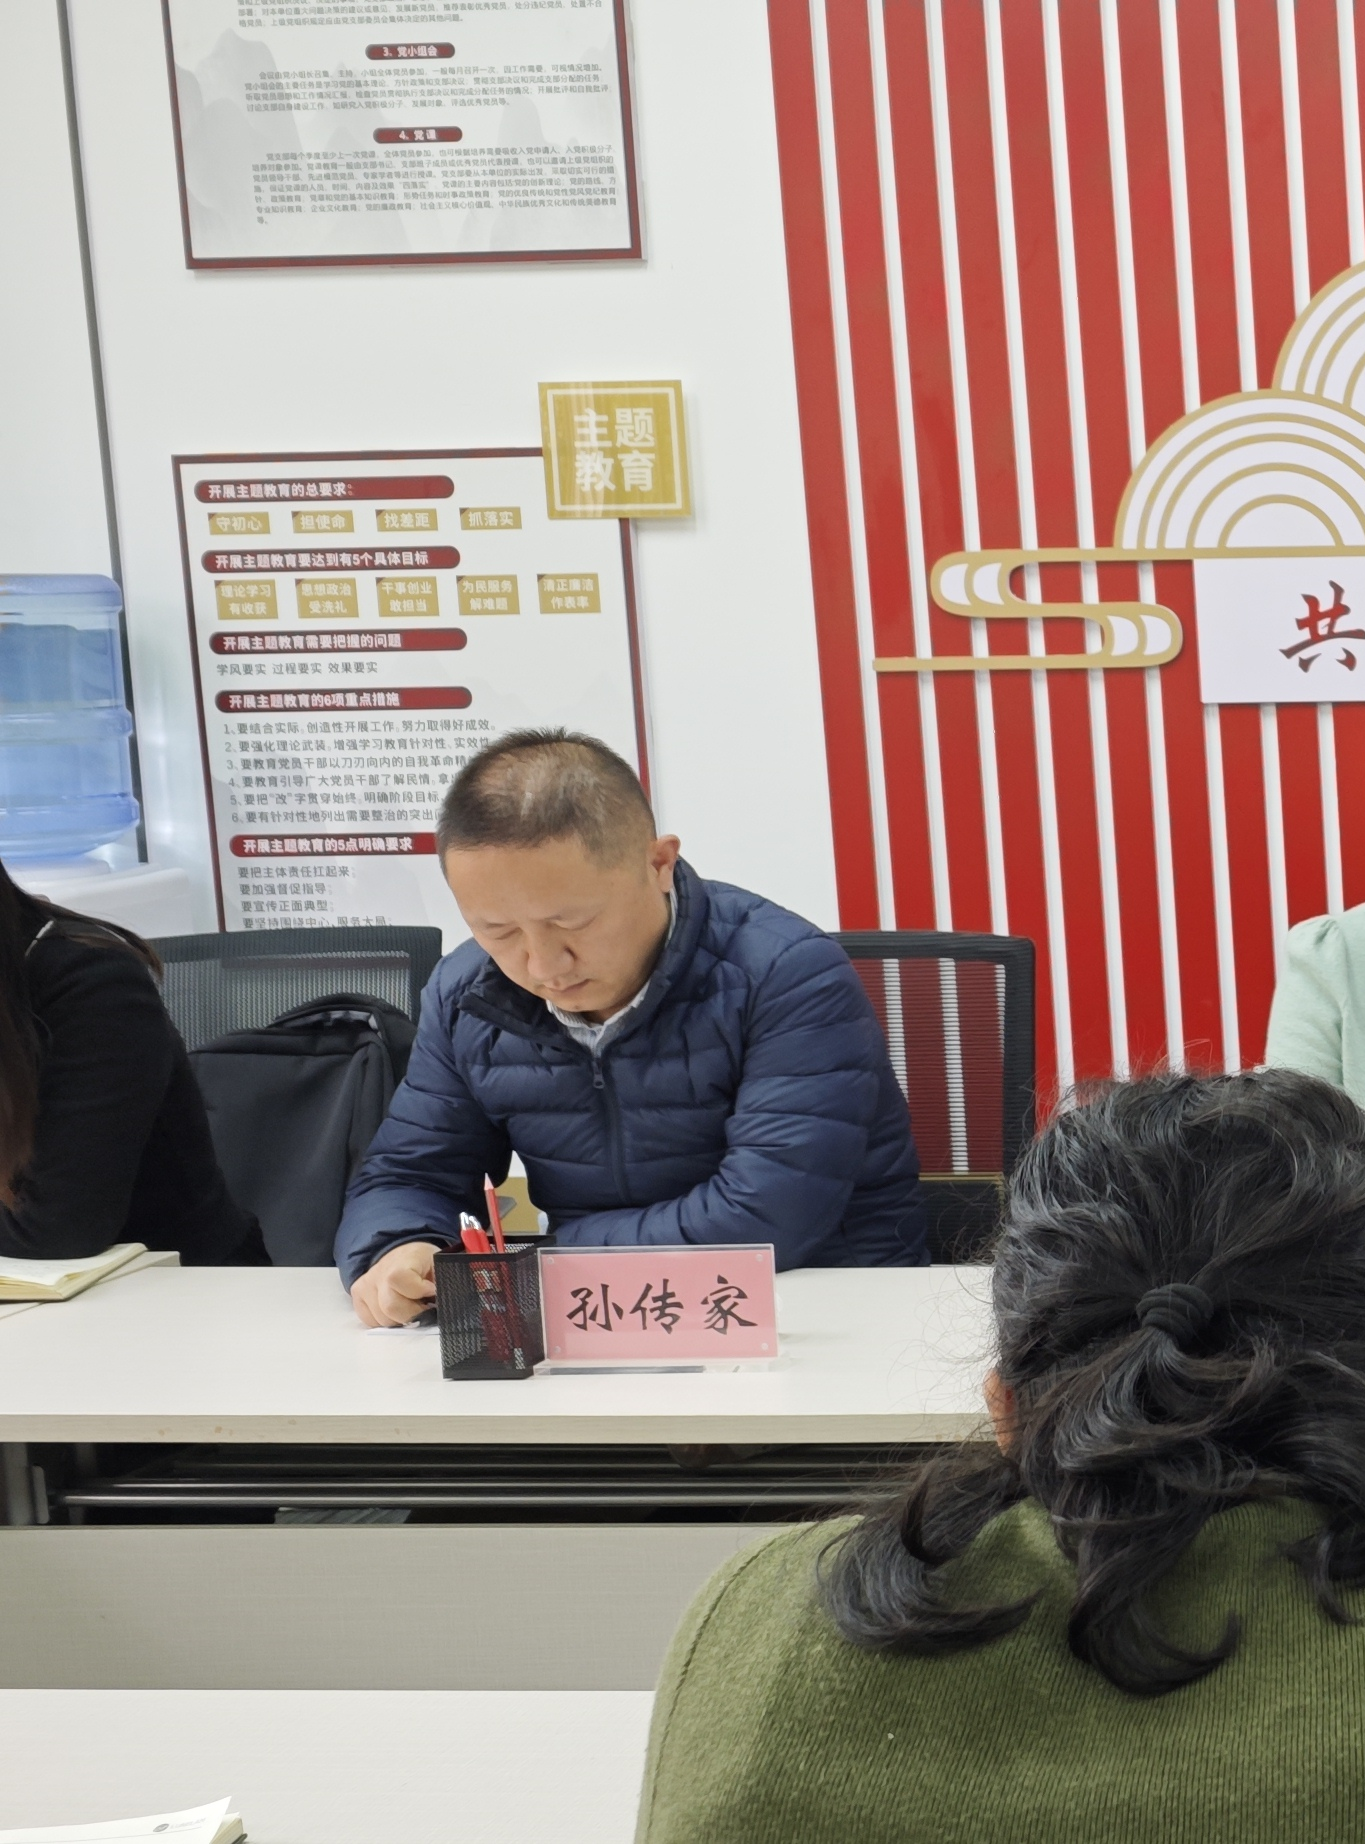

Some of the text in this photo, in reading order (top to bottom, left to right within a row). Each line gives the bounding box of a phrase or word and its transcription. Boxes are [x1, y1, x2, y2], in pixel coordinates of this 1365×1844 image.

[573, 408, 655, 448] 主题
[575, 451, 656, 492] 教育
[216, 516, 262, 532] 守初心
[300, 514, 346, 530] 担使命
[384, 512, 430, 529] 找差距
[468, 511, 514, 527] 抓落实
[215, 551, 429, 569] 开展主题教育要达到有5个具体目标
[221, 584, 271, 598] 理论学习
[301, 582, 352, 597] 思想政治
[381, 581, 432, 595] 干事创业
[462, 579, 513, 594] 为民服务
[543, 578, 594, 592] 清正廉洁
[228, 602, 267, 615] 有收获
[308, 600, 347, 614] 受洗礼
[389, 599, 427, 613] 敢担当
[469, 597, 508, 611] 解难题
[550, 596, 589, 610] 作表率
[222, 632, 402, 650] 开展主题教育需要把握的问题
[216, 661, 378, 676] 学风要实 过程要实 效果要实
[228, 692, 400, 709] 开展主题教育的6项重点措施
[226, 755, 470, 770] 3、要教育党员干部以刀刃向内的自我革命精
[228, 772, 457, 788] 4、要教育引导广大党员干部了解民情。拿
[243, 837, 412, 854] 开展主题教育的5点明确要求
[566, 1275, 759, 1335] 孙传家
